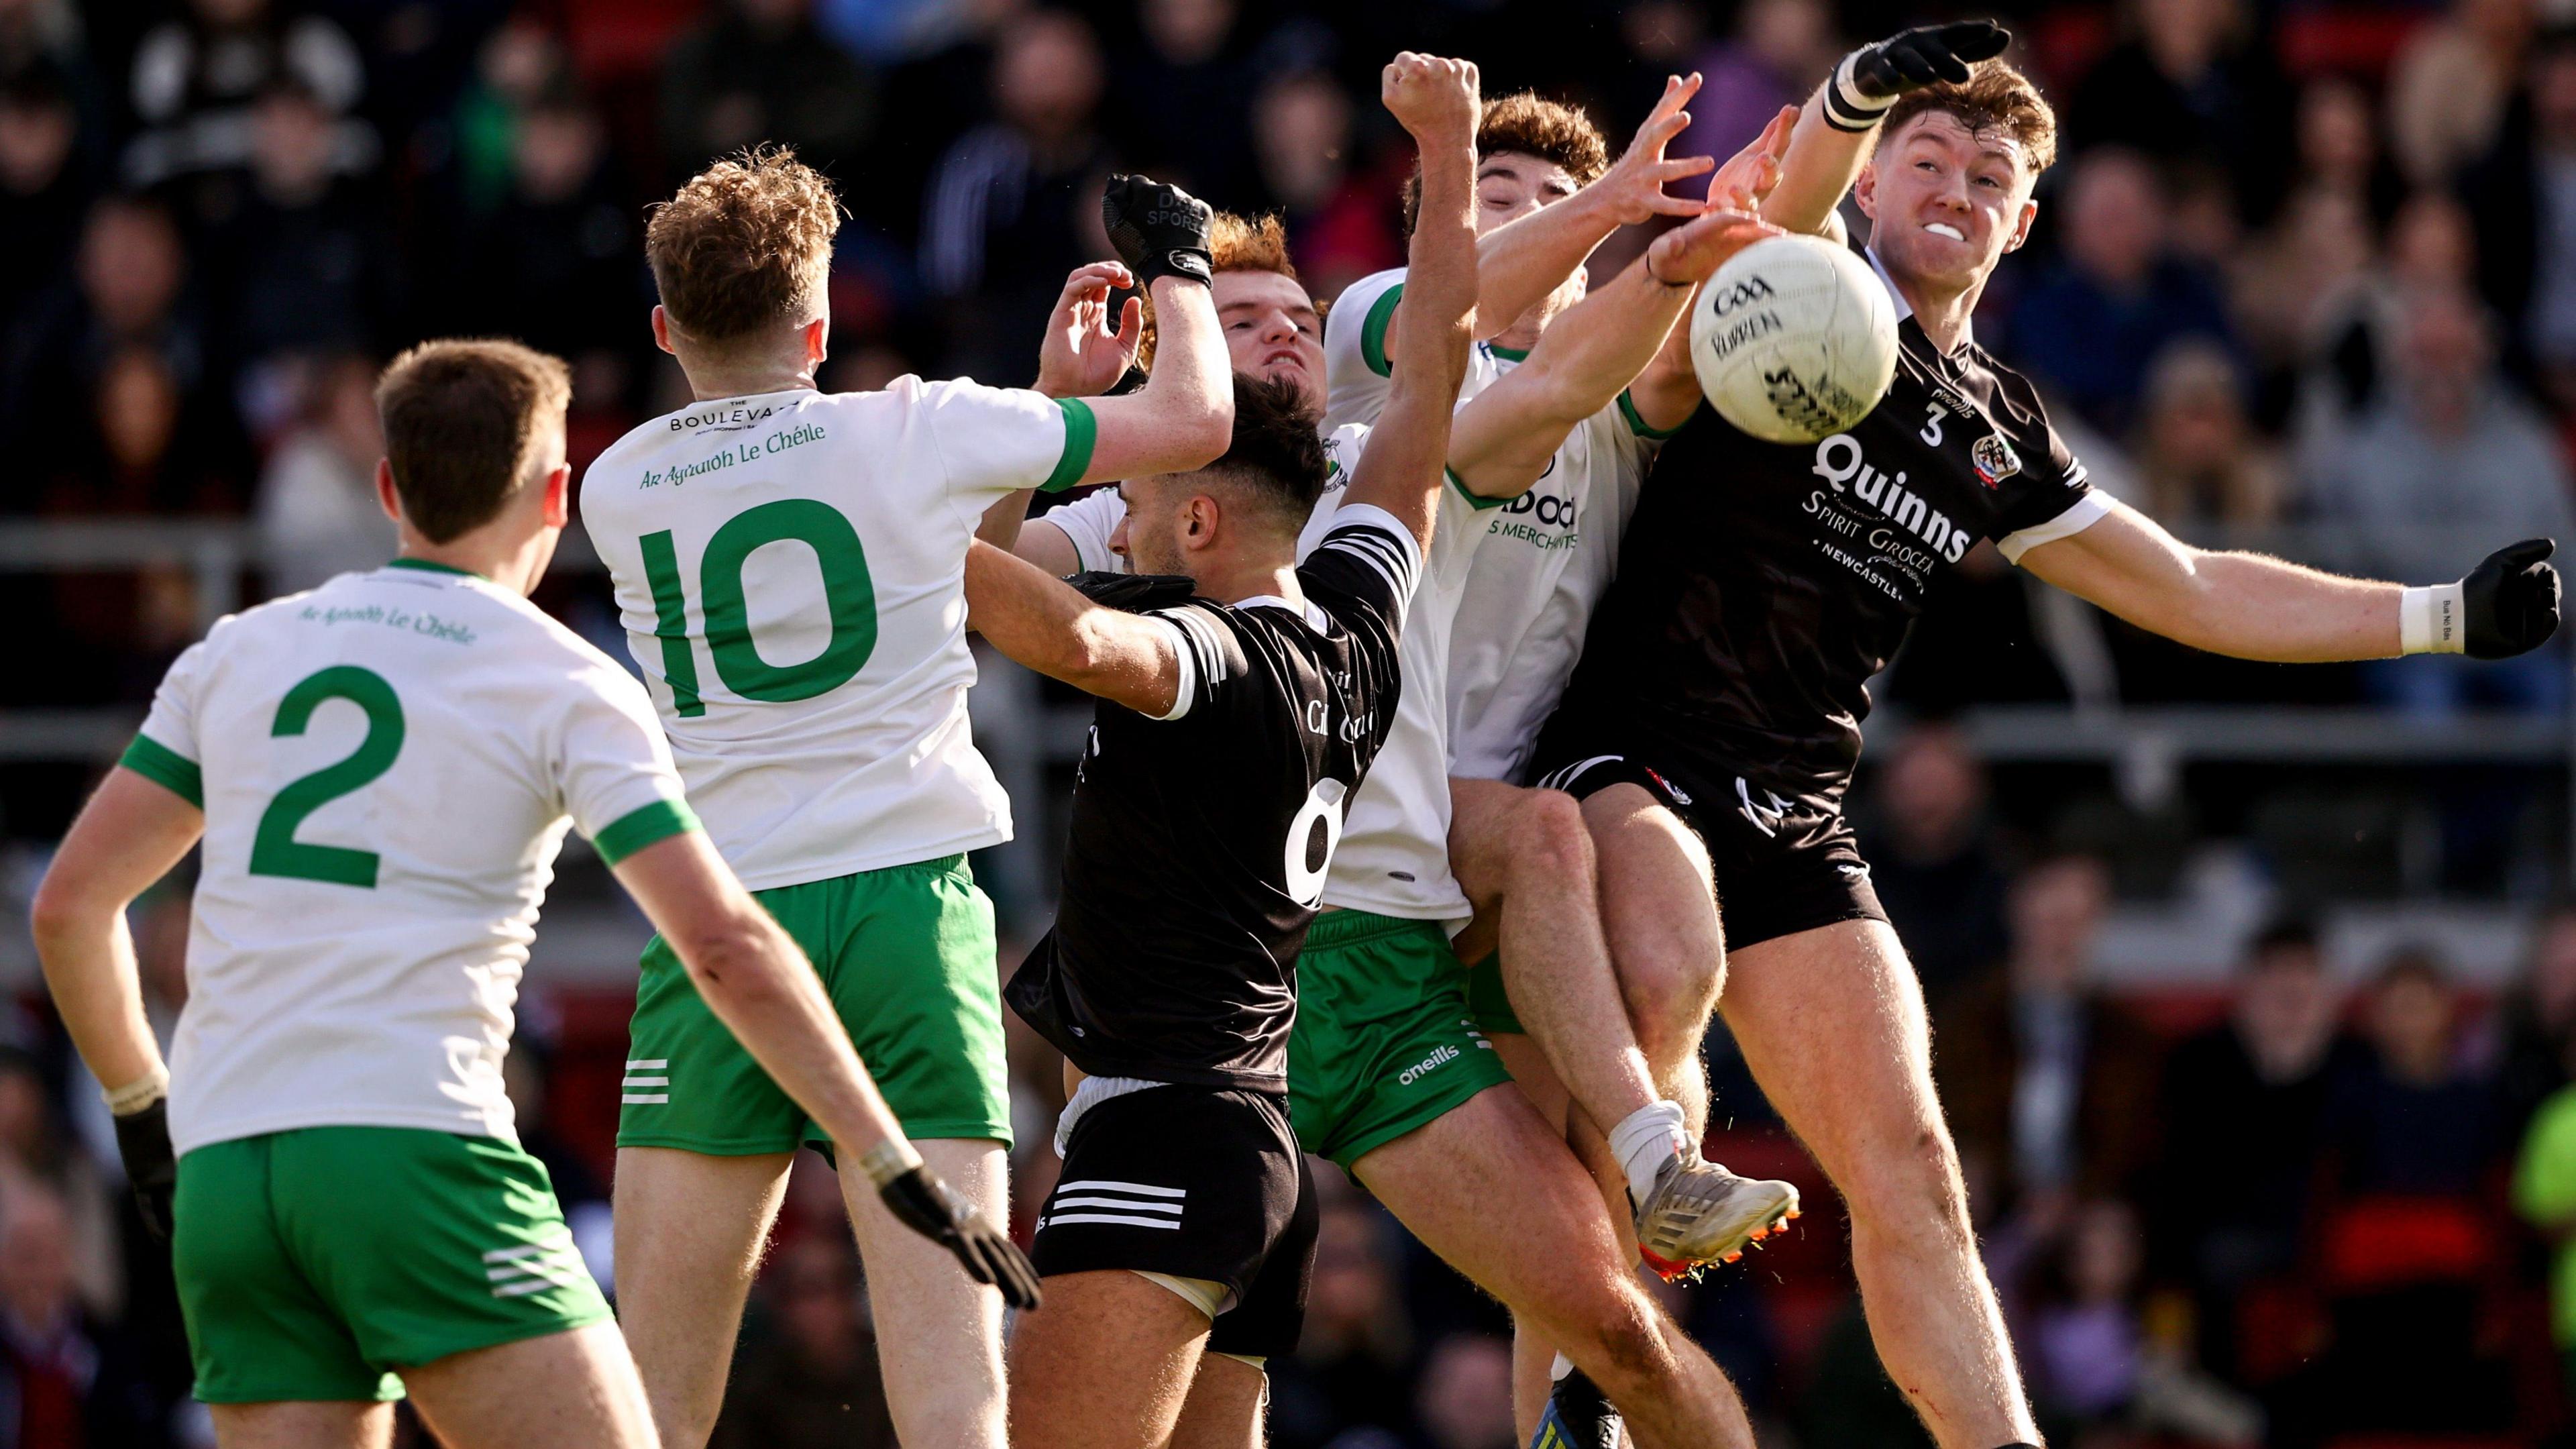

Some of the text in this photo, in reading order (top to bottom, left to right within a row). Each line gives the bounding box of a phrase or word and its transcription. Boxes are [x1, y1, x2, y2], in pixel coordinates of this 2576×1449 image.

[671, 401, 799, 431] BOULEVA
[739, 444, 760, 462] Le
[767, 423, 826, 453] Chéile
[1920, 402, 1949, 447] 3
[1812, 434, 1971, 564] Quinns
[639, 498, 878, 718] 10
[249, 664, 406, 889] 2
